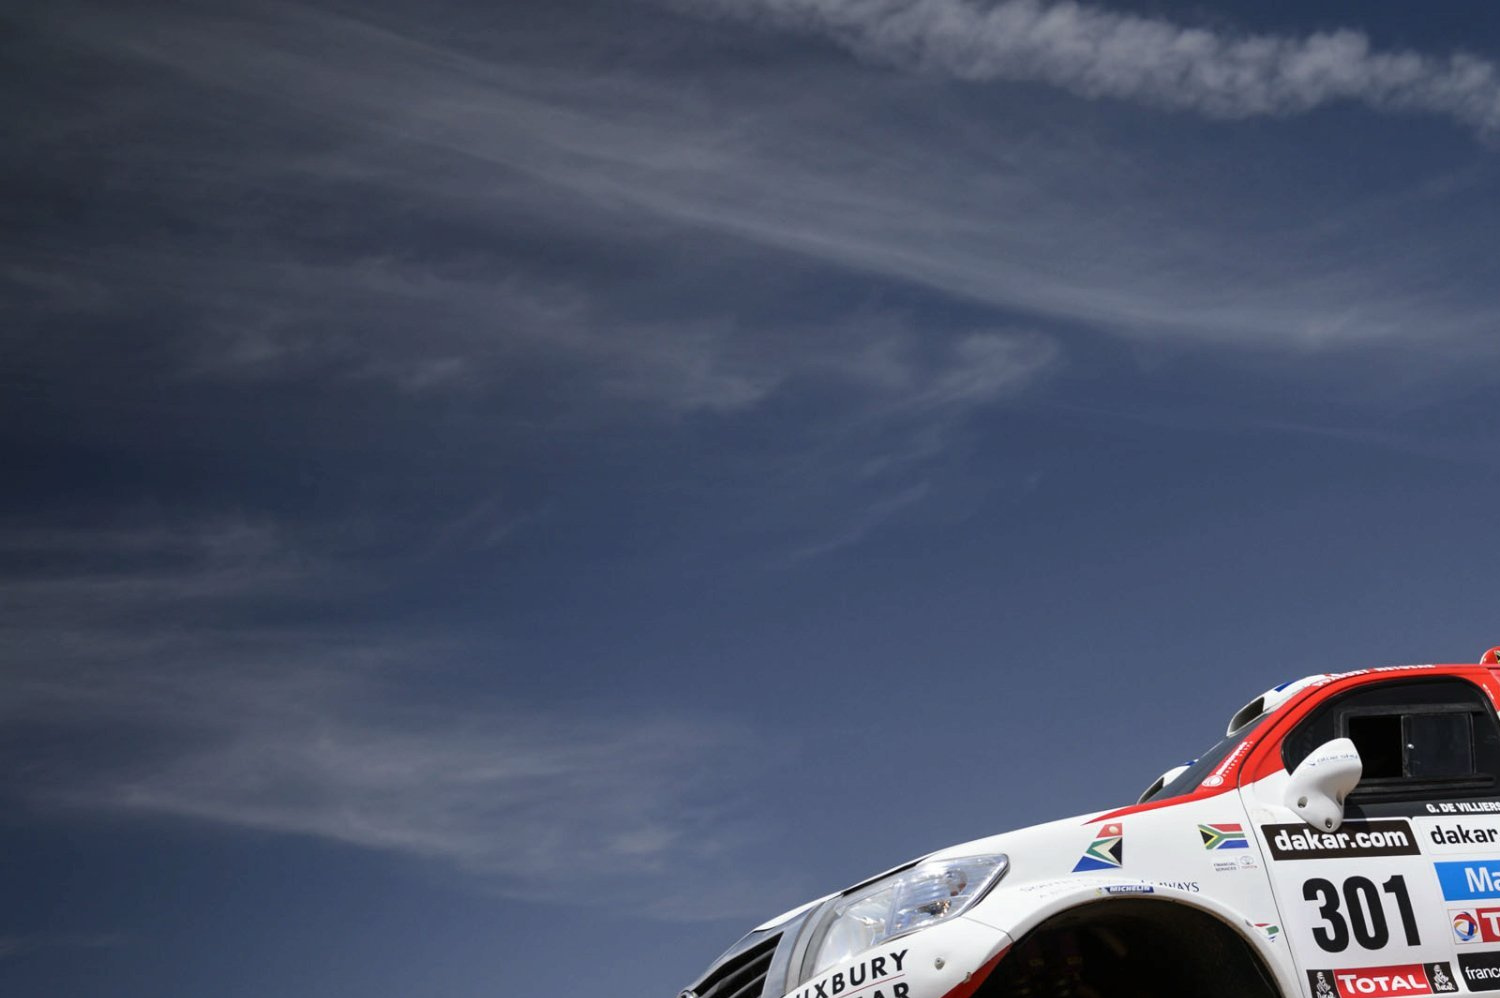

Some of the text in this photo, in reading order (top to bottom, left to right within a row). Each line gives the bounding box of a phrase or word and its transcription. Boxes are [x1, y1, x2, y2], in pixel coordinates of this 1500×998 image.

[1426, 803, 1437, 813] G.
[1439, 803, 1457, 813] DE
[1274, 829, 1409, 851] dakar.com
[1109, 884, 1151, 893] MICHELIN
[1302, 875, 1422, 953] 301
[1338, 974, 1427, 995] TOTAL
